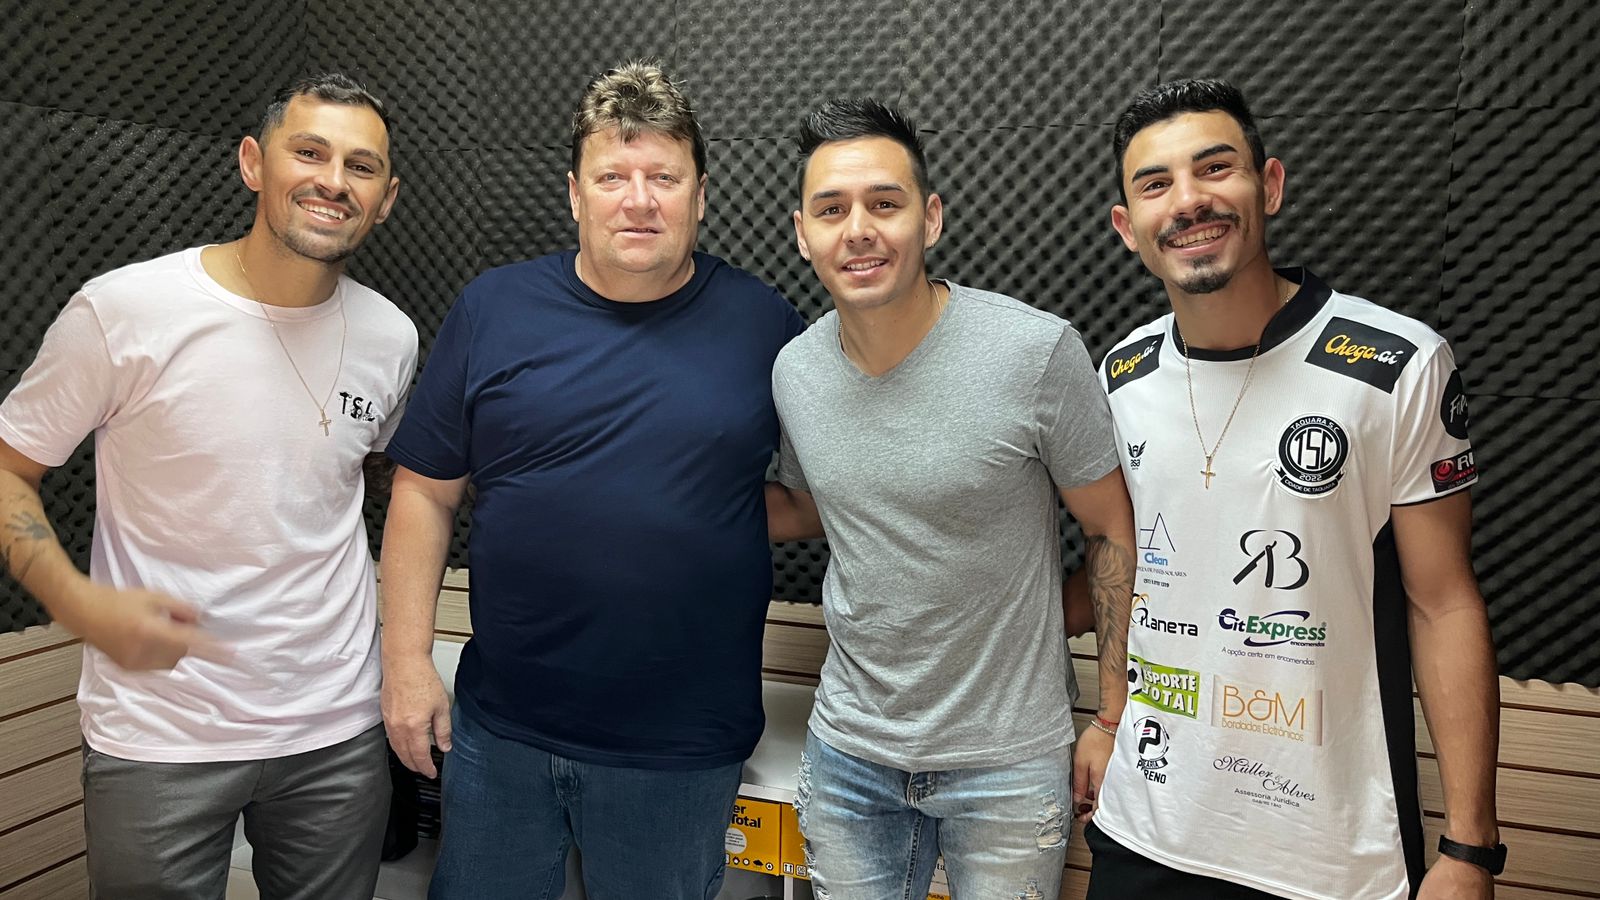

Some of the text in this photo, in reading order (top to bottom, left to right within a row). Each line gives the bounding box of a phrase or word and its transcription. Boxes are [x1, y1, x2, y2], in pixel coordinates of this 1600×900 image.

[1324, 334, 1404, 365] Chega.aí
[1290, 417, 1327, 430] TAQUARA
[1294, 428, 1335, 470] TSC
[1284, 479, 1303, 491] CIDADE
[1312, 481, 1336, 492] TAQUARA
[1299, 473, 1323, 482] 2022
[1144, 552, 1169, 566] Clean
[1217, 608, 1327, 641] CitExpress
[1227, 648, 1246, 657] opção
[1247, 650, 1263, 658] certa
[1276, 654, 1315, 666] encomendas
[1223, 685, 1305, 731] B&M
[1221, 718, 1261, 733] Bordados
[1234, 788, 1271, 801] Assessoria
[1262, 779, 1316, 802] Alves
[731, 813, 761, 829] Total
